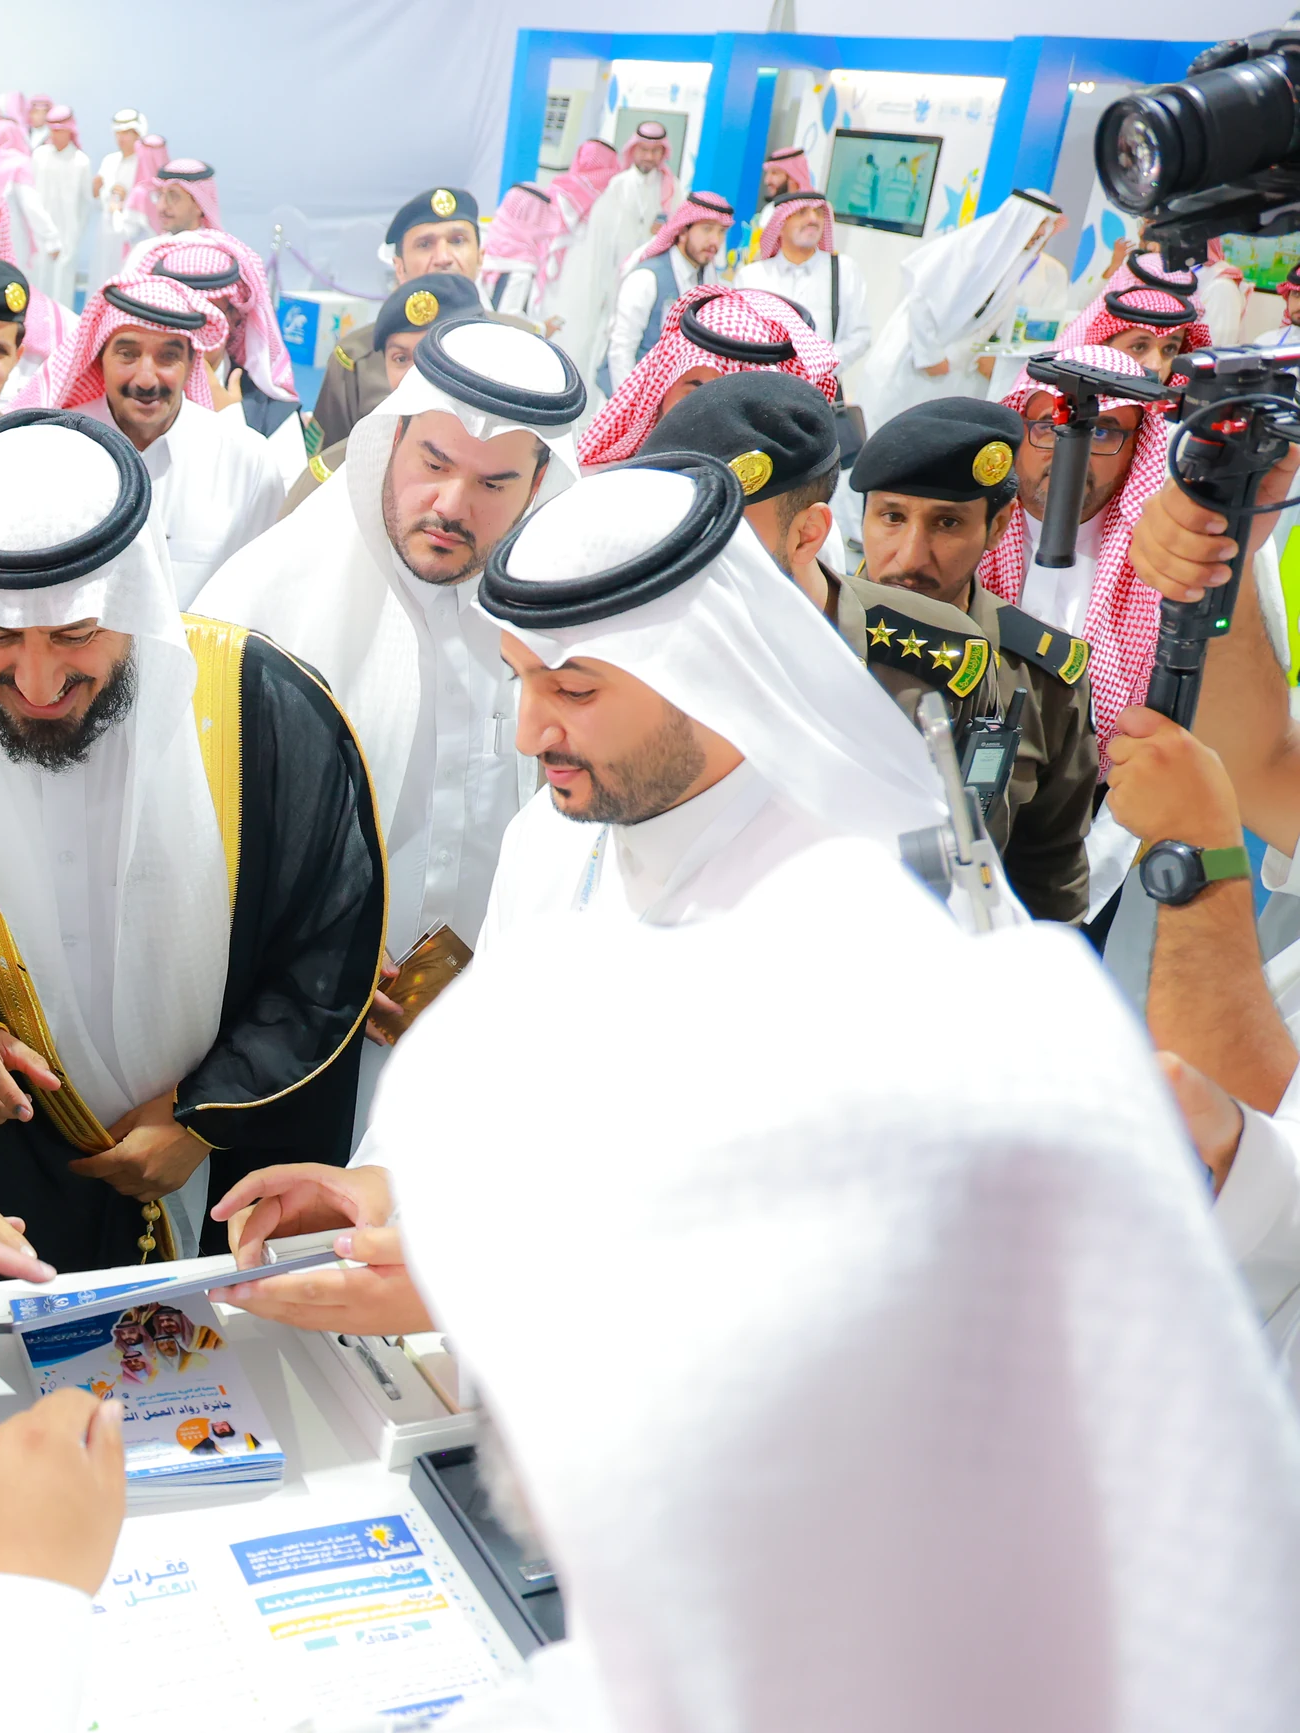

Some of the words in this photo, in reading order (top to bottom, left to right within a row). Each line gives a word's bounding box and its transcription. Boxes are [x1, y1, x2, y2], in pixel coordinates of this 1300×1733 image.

[179, 1404, 200, 1415] رواد
[203, 1400, 231, 1412] جائزة
[143, 1406, 175, 1421] العمل
[112, 1558, 189, 1586] فقرات
